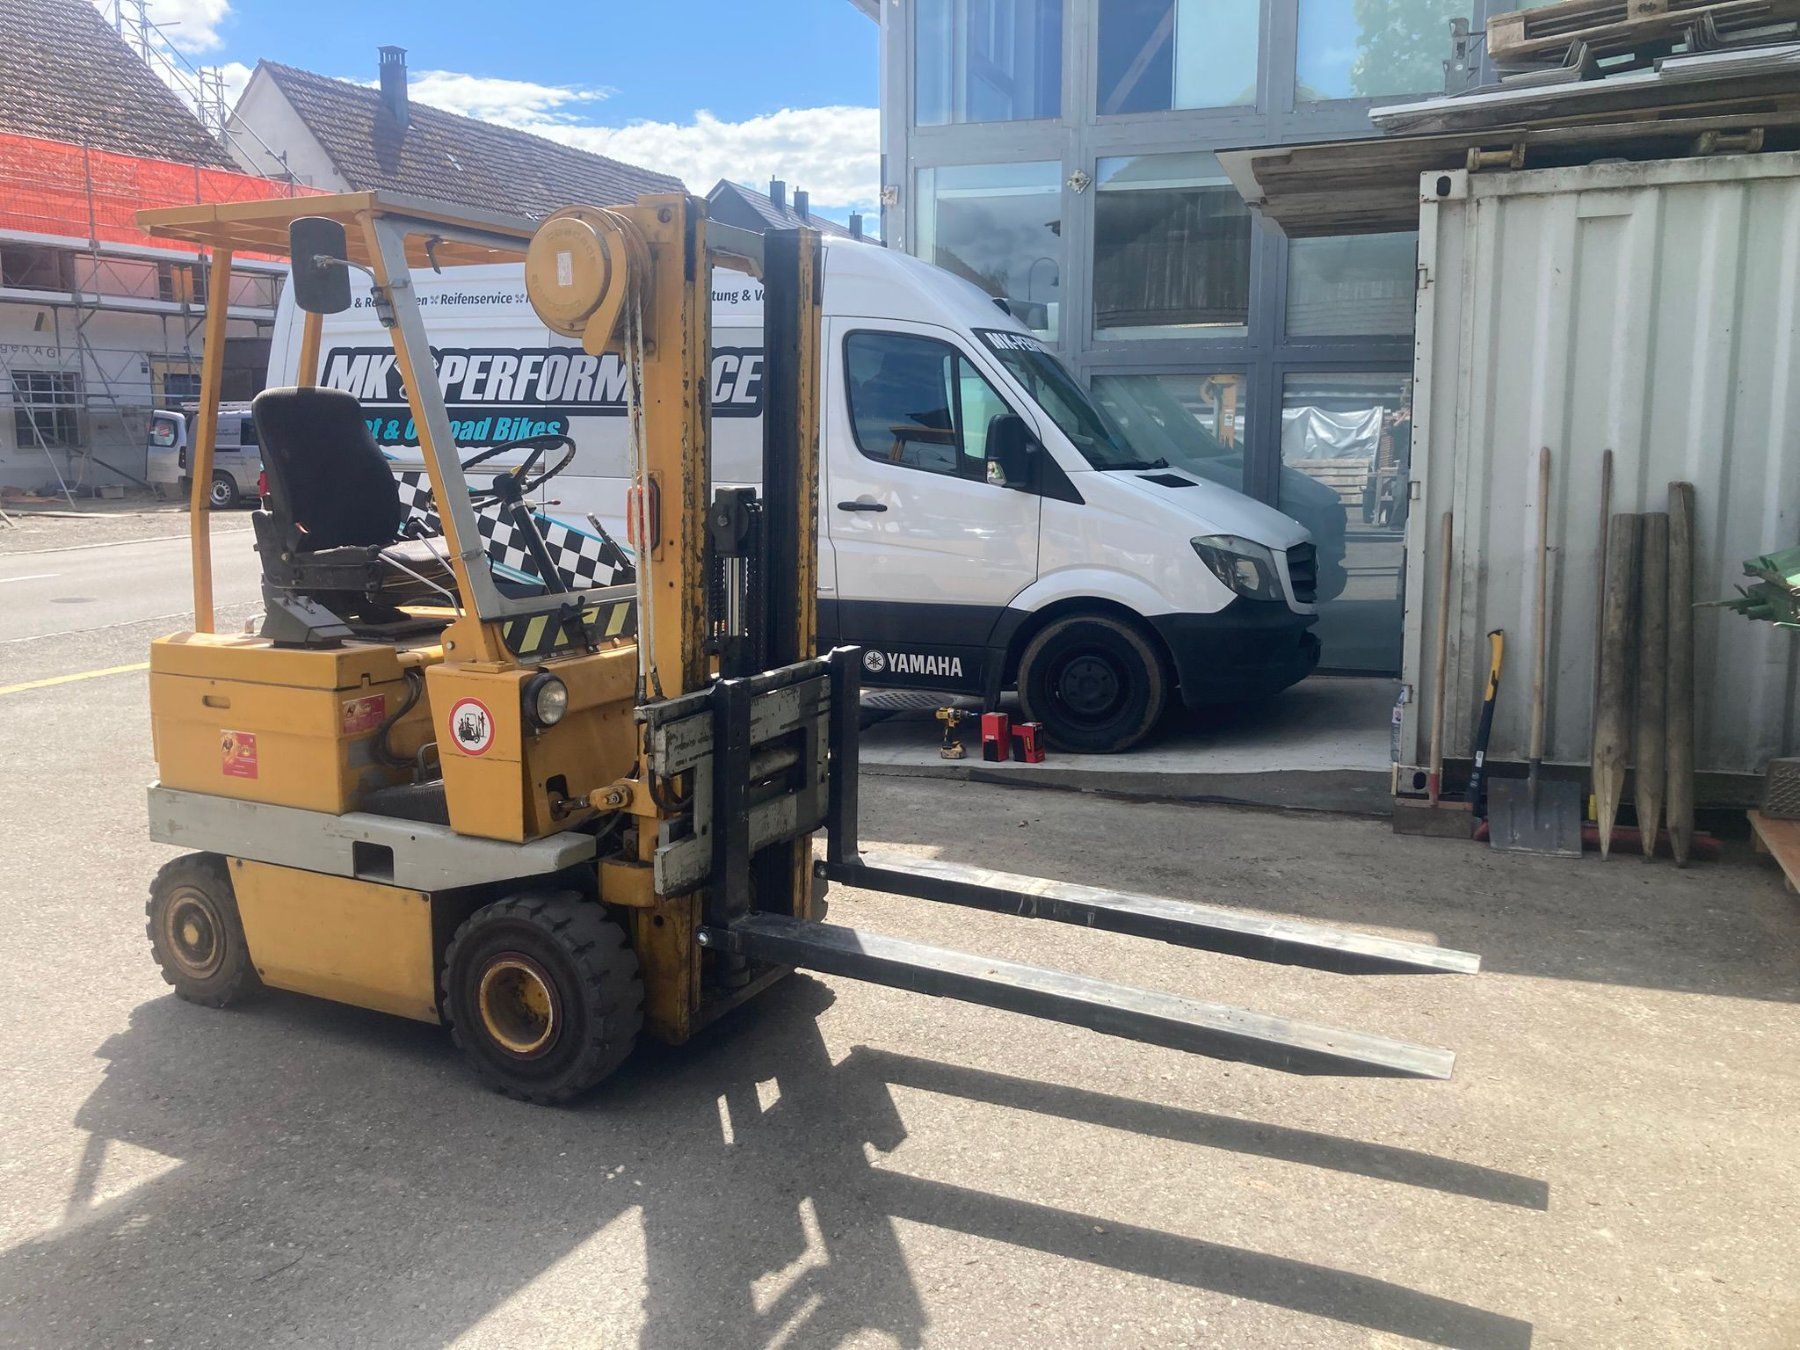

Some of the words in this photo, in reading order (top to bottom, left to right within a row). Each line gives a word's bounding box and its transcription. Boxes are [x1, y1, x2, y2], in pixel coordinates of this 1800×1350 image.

[354, 297, 363, 309] &
[440, 291, 513, 306] Reifenservice
[711, 290, 739, 305] tung
[741, 289, 751, 301] &
[327, 354, 397, 400] MK
[438, 354, 764, 404] PERFORMCE
[383, 419, 400, 440] &
[404, 417, 493, 441] Ooad
[492, 416, 561, 441] Bikes
[887, 652, 963, 678] YAMAHA
